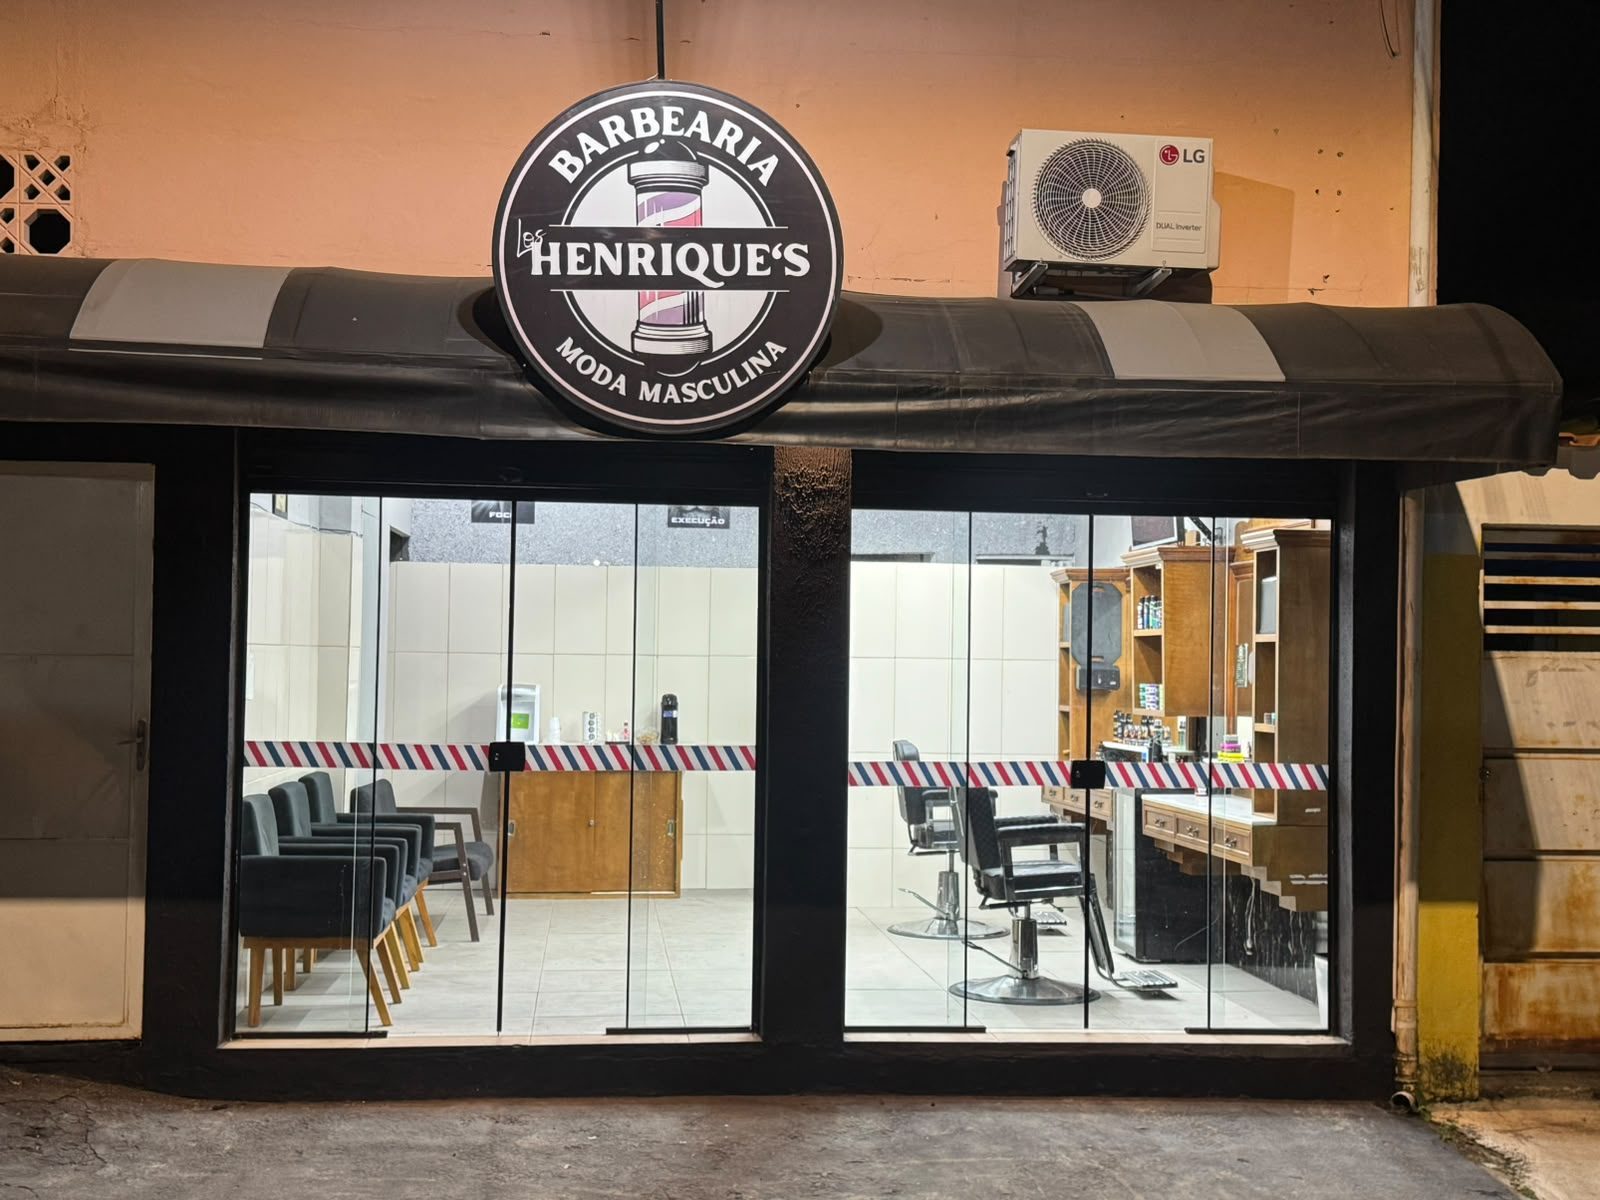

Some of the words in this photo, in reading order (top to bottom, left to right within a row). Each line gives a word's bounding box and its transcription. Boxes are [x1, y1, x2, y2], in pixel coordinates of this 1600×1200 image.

[548, 106, 779, 187] BARBEARIA
[1183, 148, 1205, 164] LG
[1156, 222, 1175, 230] DUAL
[1175, 223, 1202, 232] Inverter
[531, 242, 811, 289] HENRIQUE'S
[556, 336, 628, 397] MODA
[638, 339, 787, 405] MASCULINA
[488, 511, 513, 519] FOC
[671, 516, 726, 527] EXECUÇÃO
